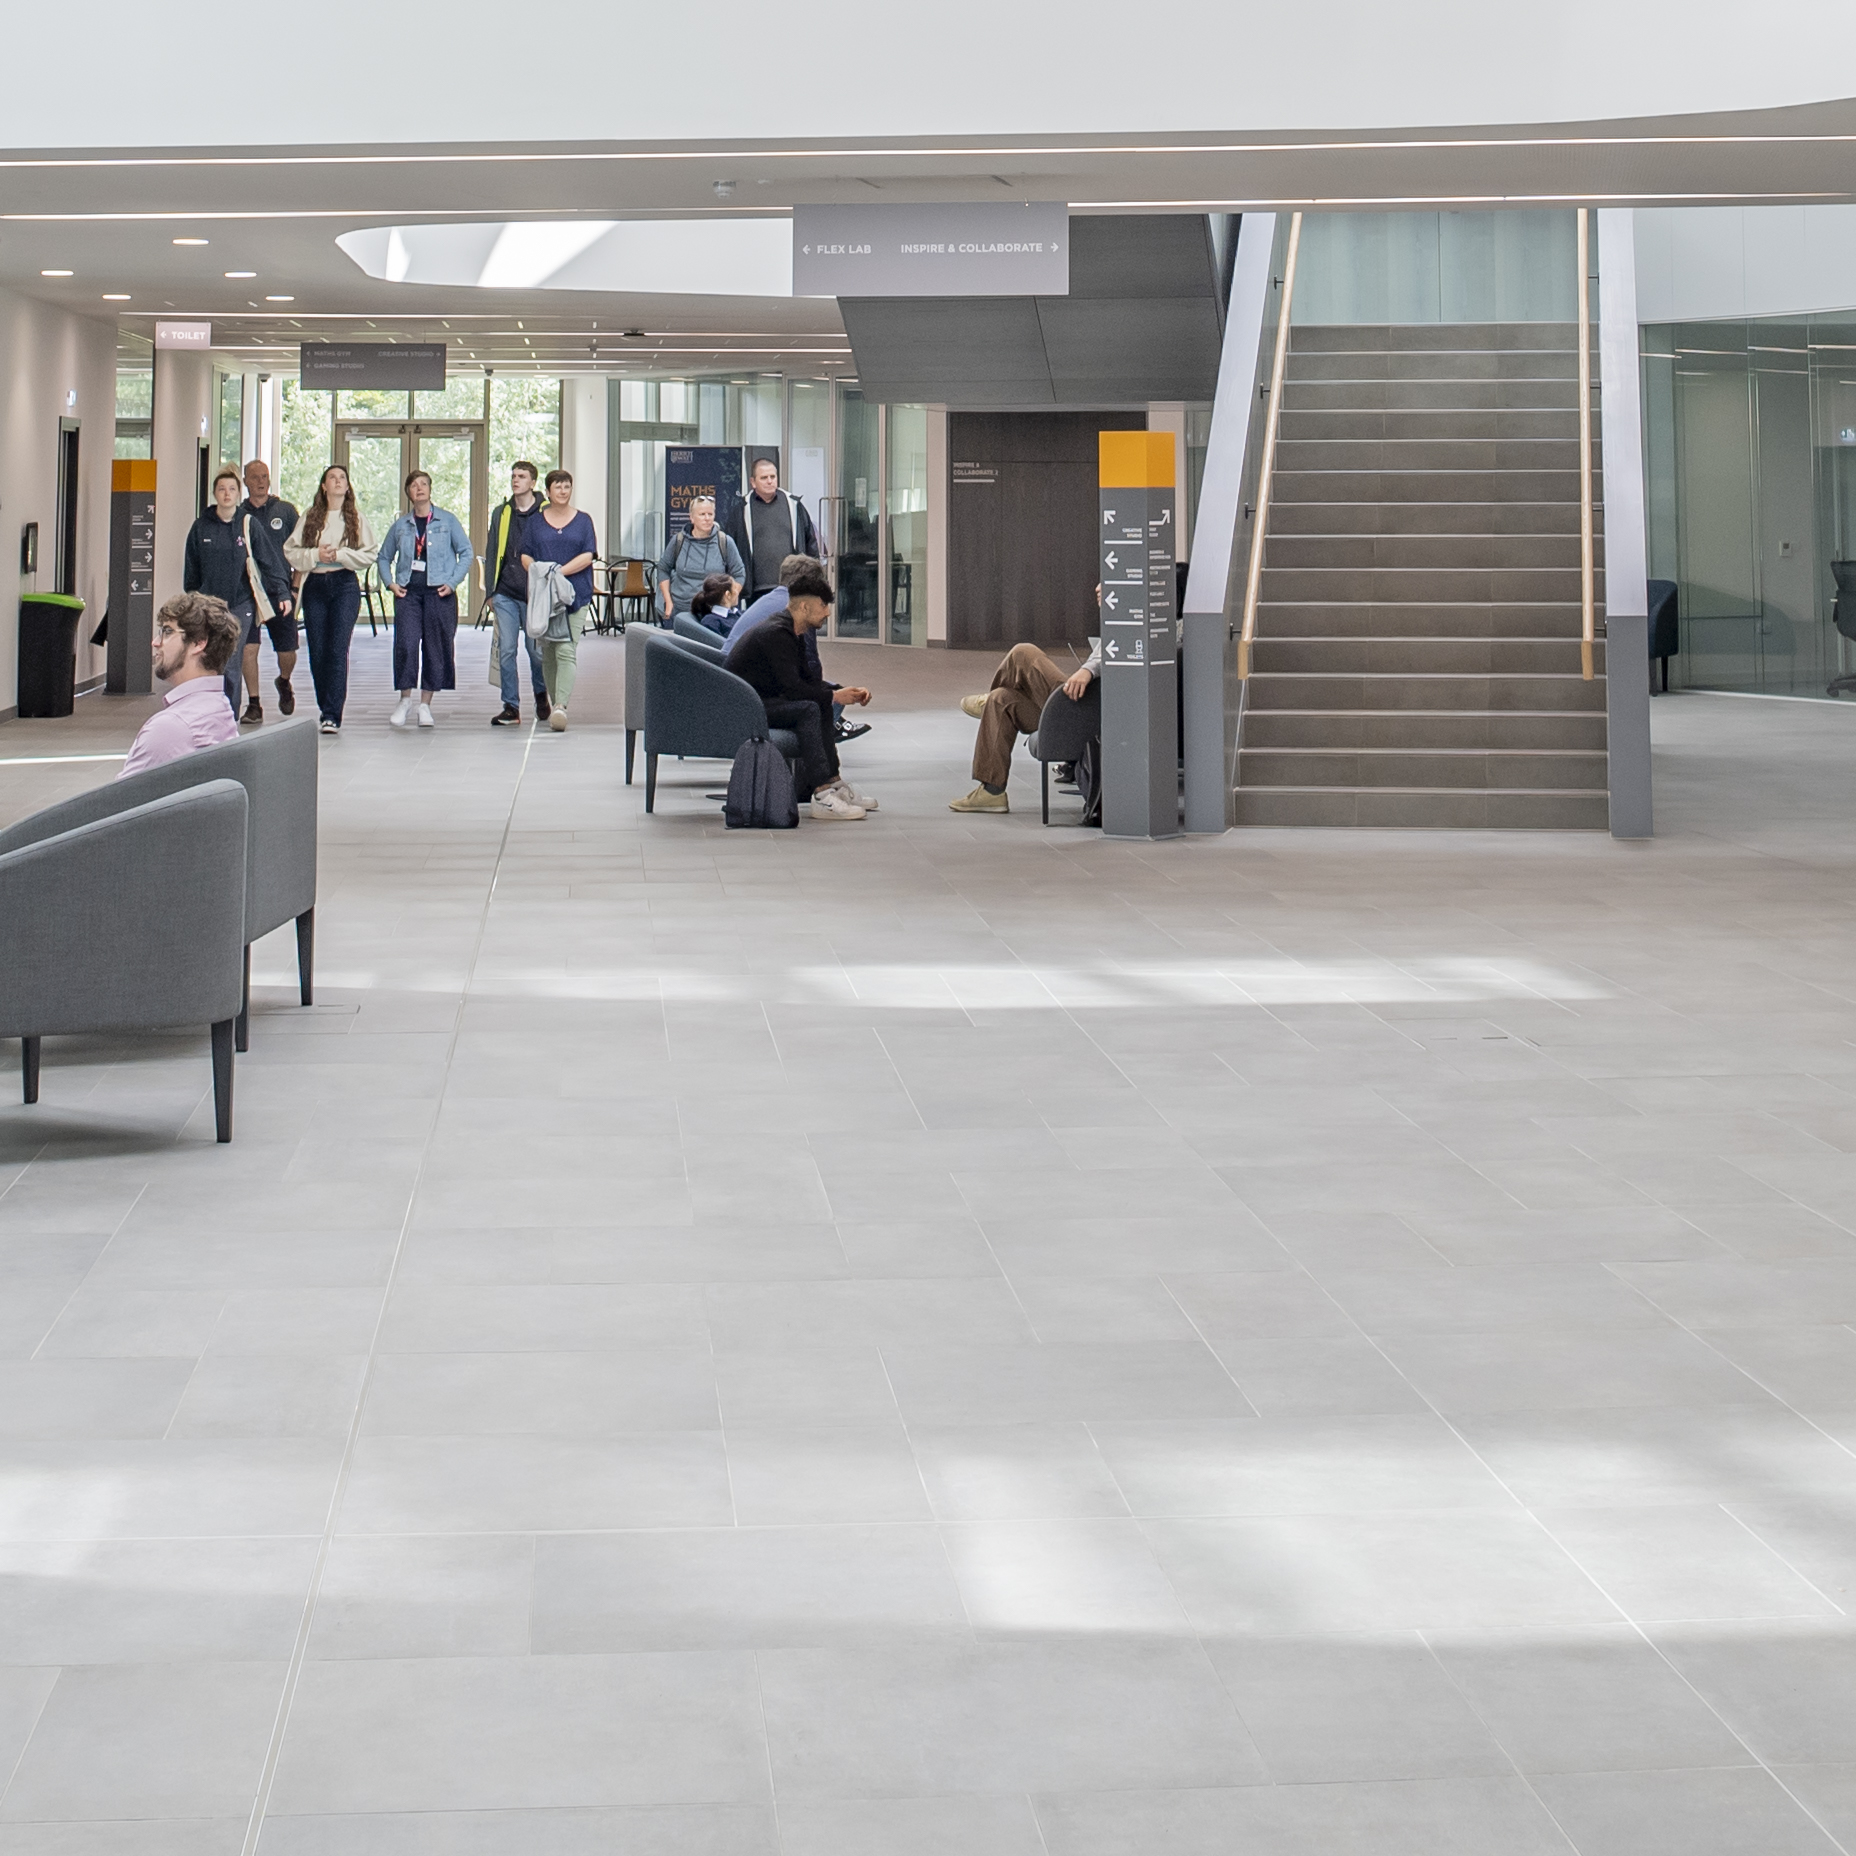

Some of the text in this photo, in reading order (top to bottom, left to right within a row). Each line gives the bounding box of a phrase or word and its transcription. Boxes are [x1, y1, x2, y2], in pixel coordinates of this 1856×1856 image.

[817, 245, 871, 254] FLEX LAB
[901, 243, 1043, 254] INSPIRE & COLLABORATE
[172, 332, 205, 340] TOILET
[670, 485, 716, 496] MATHS
